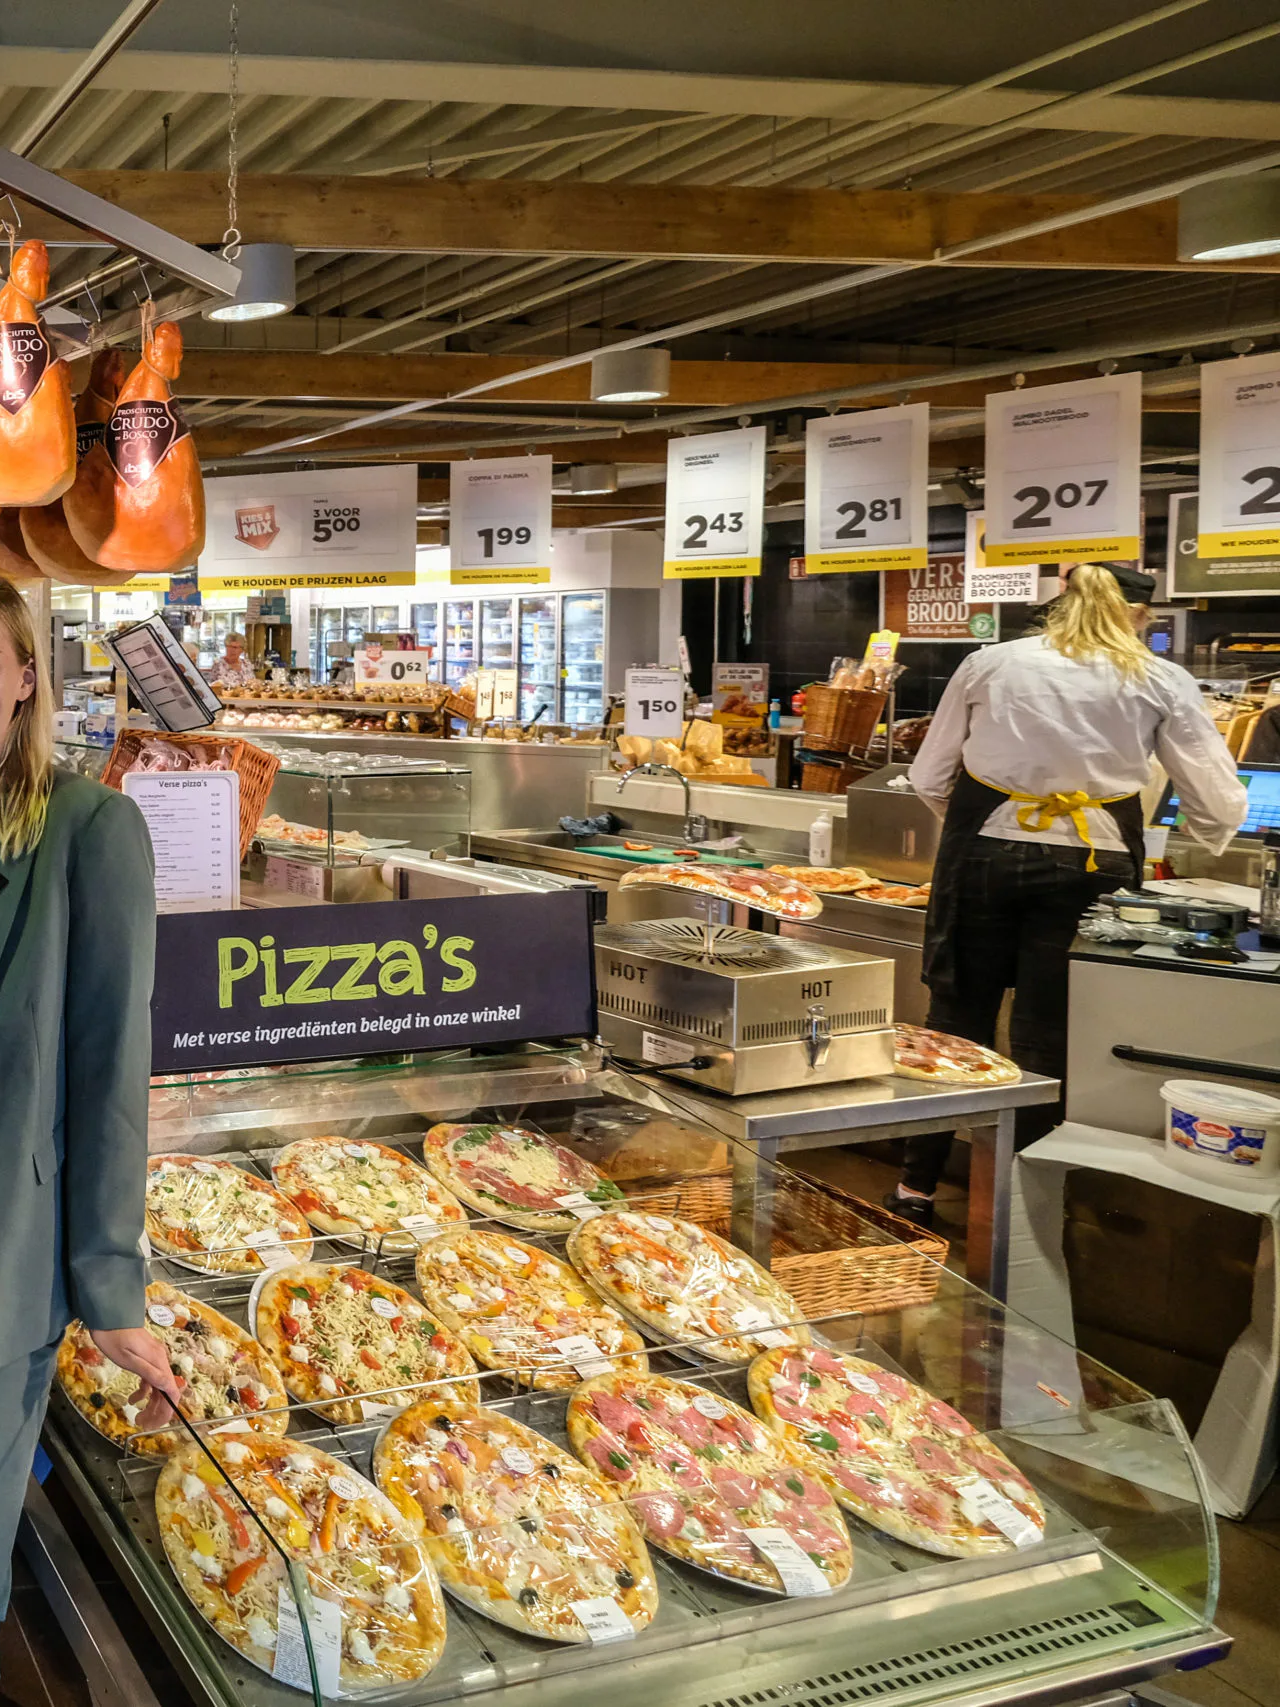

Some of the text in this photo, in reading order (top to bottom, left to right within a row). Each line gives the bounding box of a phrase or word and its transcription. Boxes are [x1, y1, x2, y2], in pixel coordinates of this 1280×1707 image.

[117, 407, 163, 416] PROSCIUTTO
[1012, 411, 1042, 421] JUMBO
[110, 416, 170, 431] CRUDO
[122, 430, 158, 440] BOSCO
[313, 507, 360, 518] 3 VOOR
[1012, 479, 1109, 530] 207
[240, 514, 264, 524] KIES
[835, 497, 902, 540] 281
[241, 521, 275, 538] MIX
[312, 517, 361, 543] 500
[683, 512, 744, 549] 243
[477, 526, 532, 558] 199
[1238, 538, 1279, 547] HOUDEN
[223, 574, 387, 587] WE HOUDEN DE PRIJZEN LAAG
[971, 572, 1032, 581] ROOMBOTER
[970, 587, 1032, 597] BROODJE
[907, 602, 970, 622] BROOD
[391, 661, 422, 680] 062
[638, 699, 677, 720] 150
[182, 779, 207, 789] pizza's
[218, 924, 478, 1009] Pizza's
[610, 960, 648, 984] HOT
[801, 980, 832, 999] HOT
[173, 1004, 521, 1049] Met verse ingrediënten belegd in onze winkel
